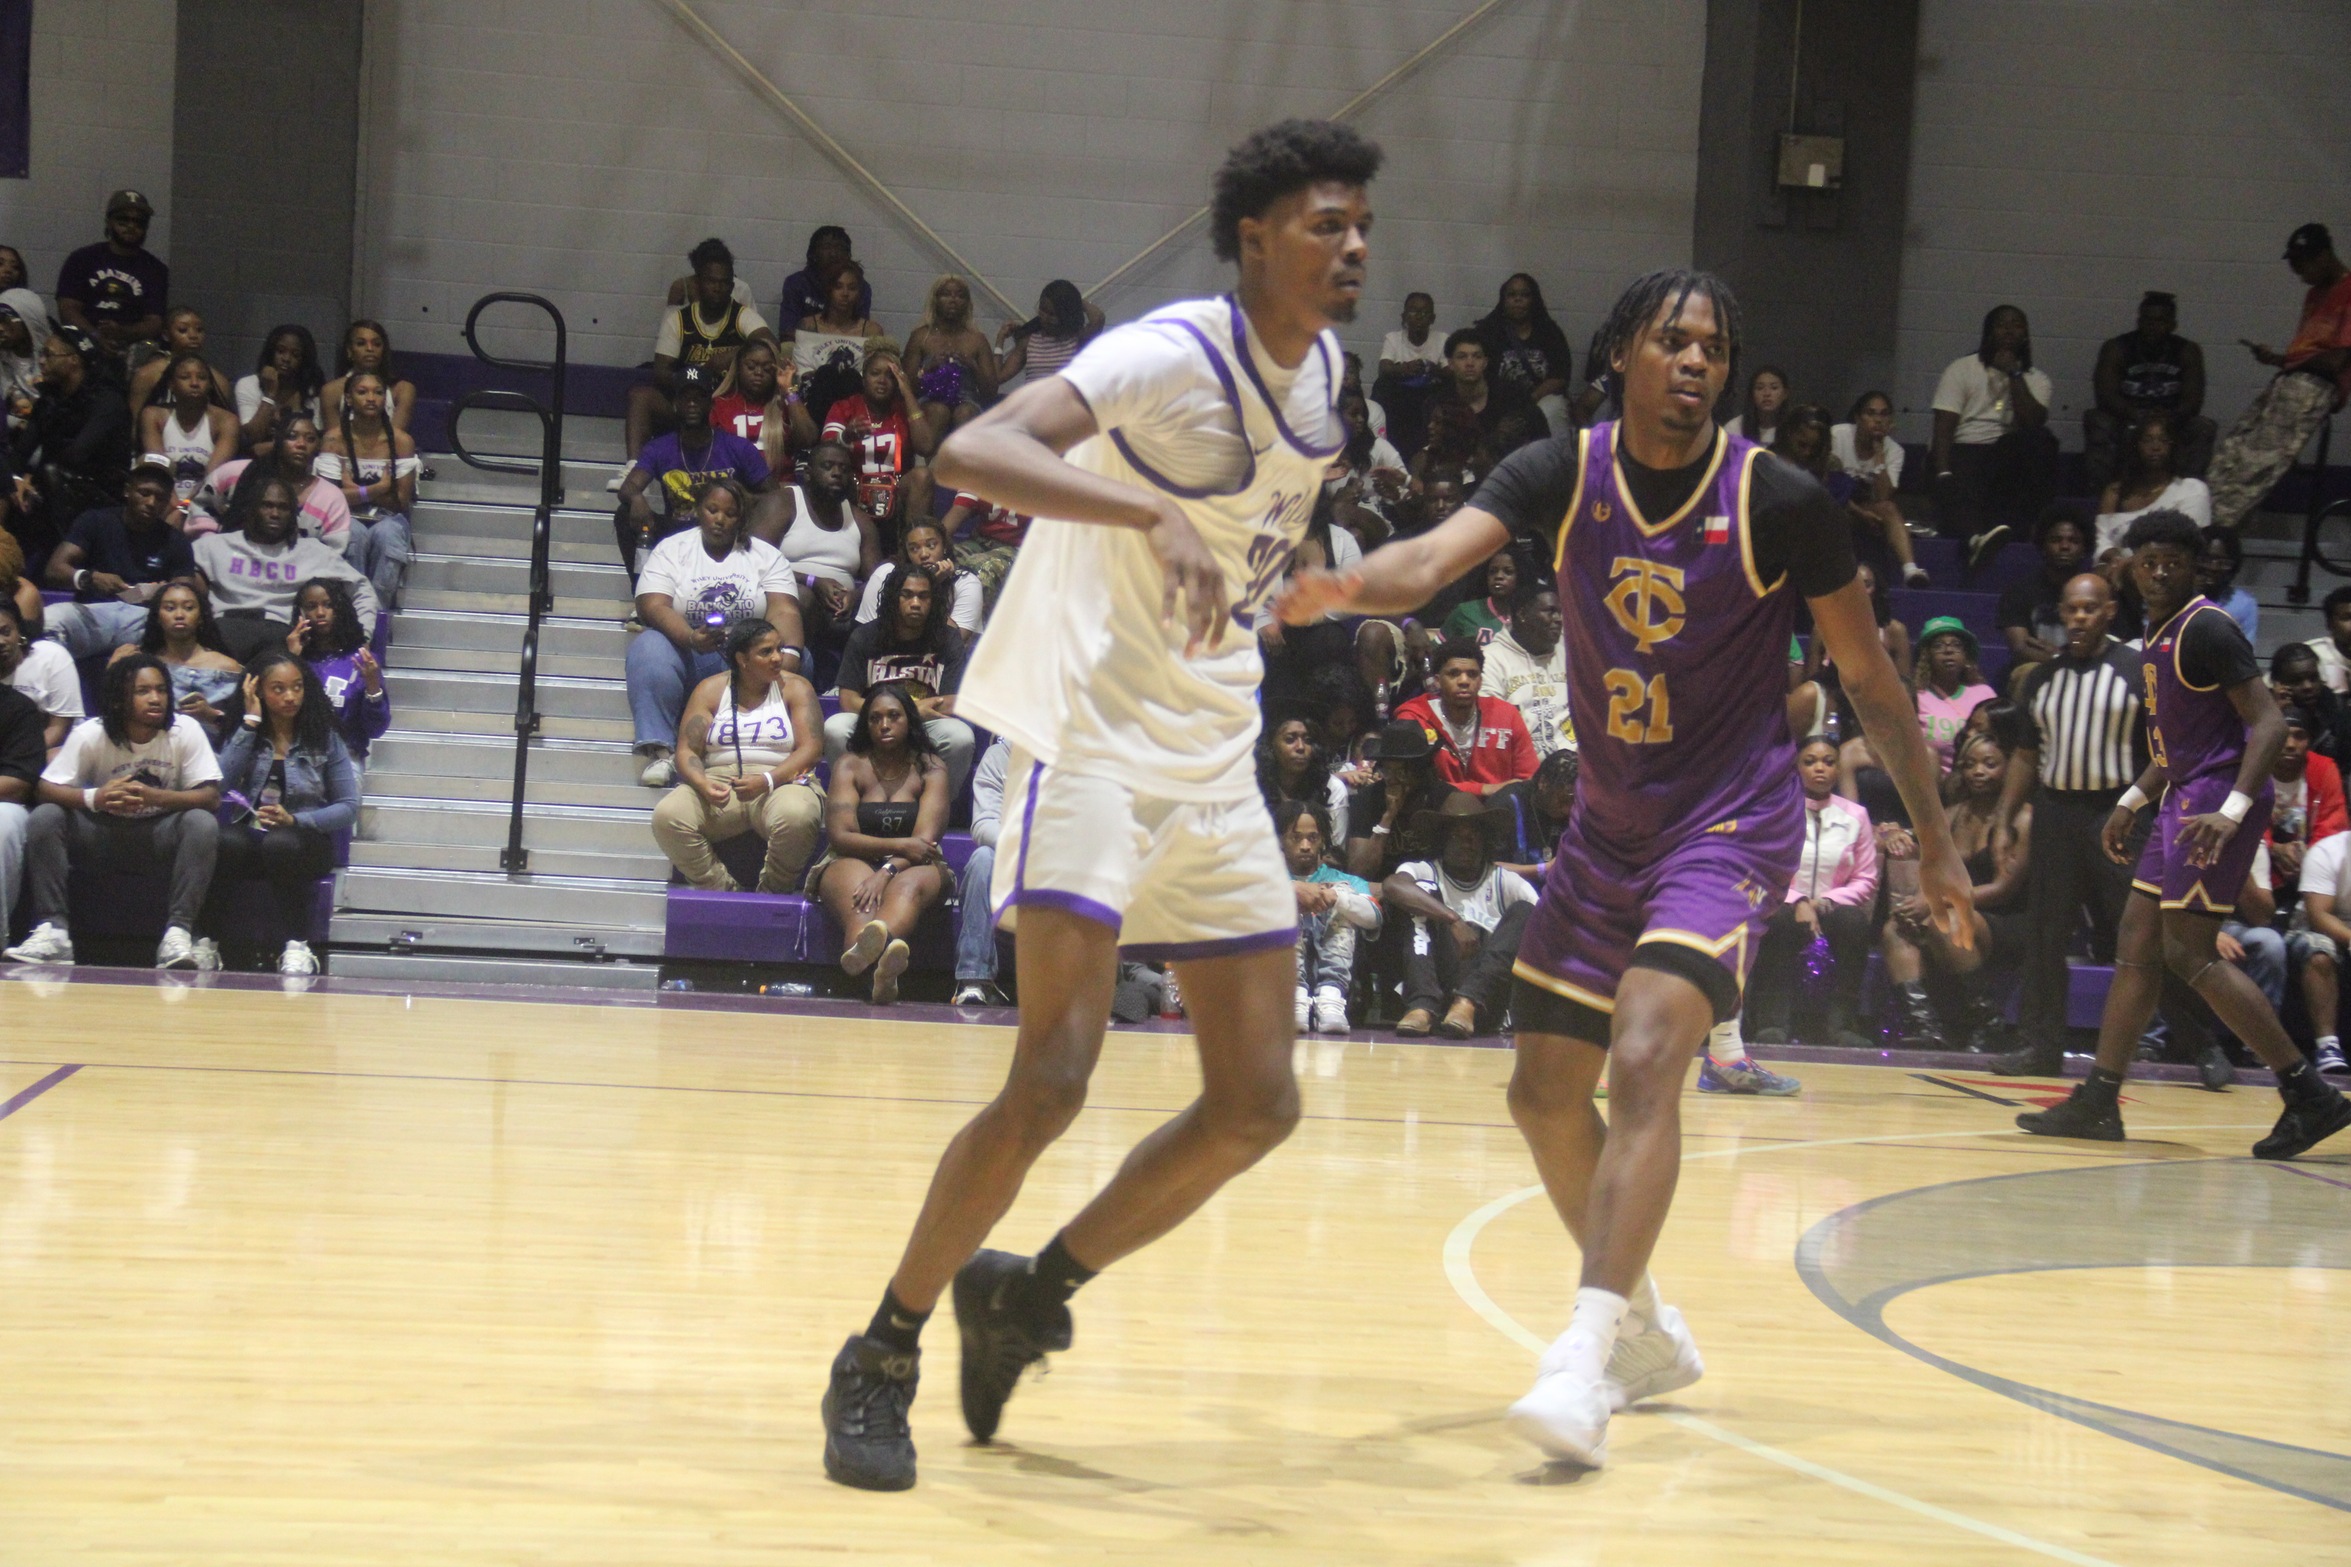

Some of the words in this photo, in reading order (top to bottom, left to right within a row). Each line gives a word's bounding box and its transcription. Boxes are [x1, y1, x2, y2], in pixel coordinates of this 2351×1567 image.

[861, 433, 896, 474] 17
[875, 503, 885, 516] 5
[229, 557, 297, 580] HBCU
[687, 600, 722, 612] BACK
[735, 599, 754, 611] TO
[1603, 667, 1673, 744] 21
[706, 716, 788, 746] 1873
[1477, 727, 1513, 750] FF
[882, 816, 903, 832] 87
